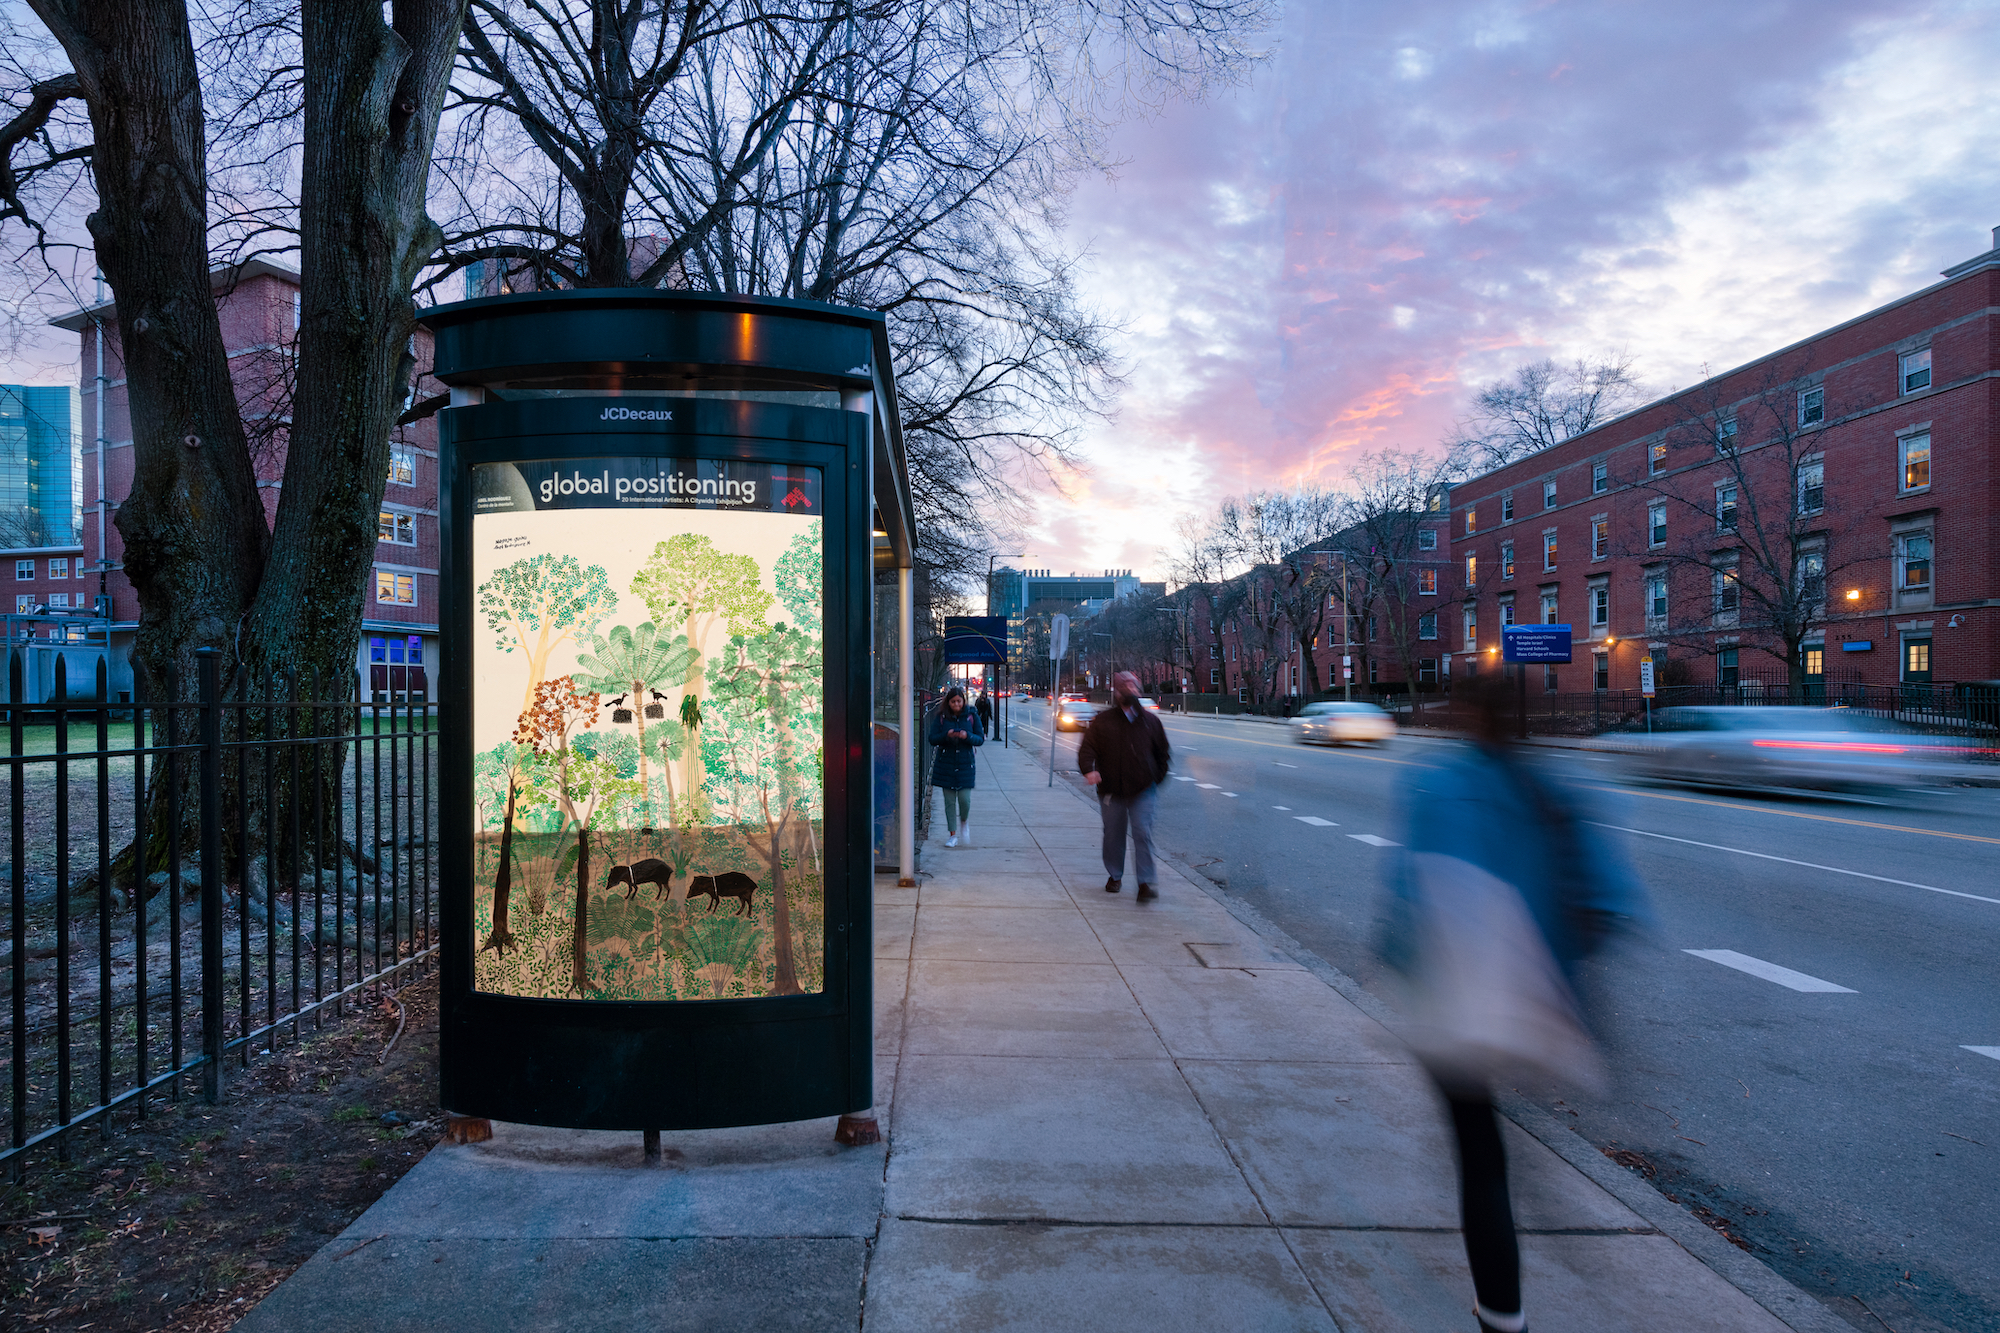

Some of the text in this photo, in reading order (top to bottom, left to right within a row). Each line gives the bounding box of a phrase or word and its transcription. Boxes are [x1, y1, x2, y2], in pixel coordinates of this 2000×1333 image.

[600, 407, 673, 421] JCDecaux
[539, 470, 756, 504] global positioning
[690, 497, 715, 505] Citywide
[715, 498, 743, 506] Exhibition
